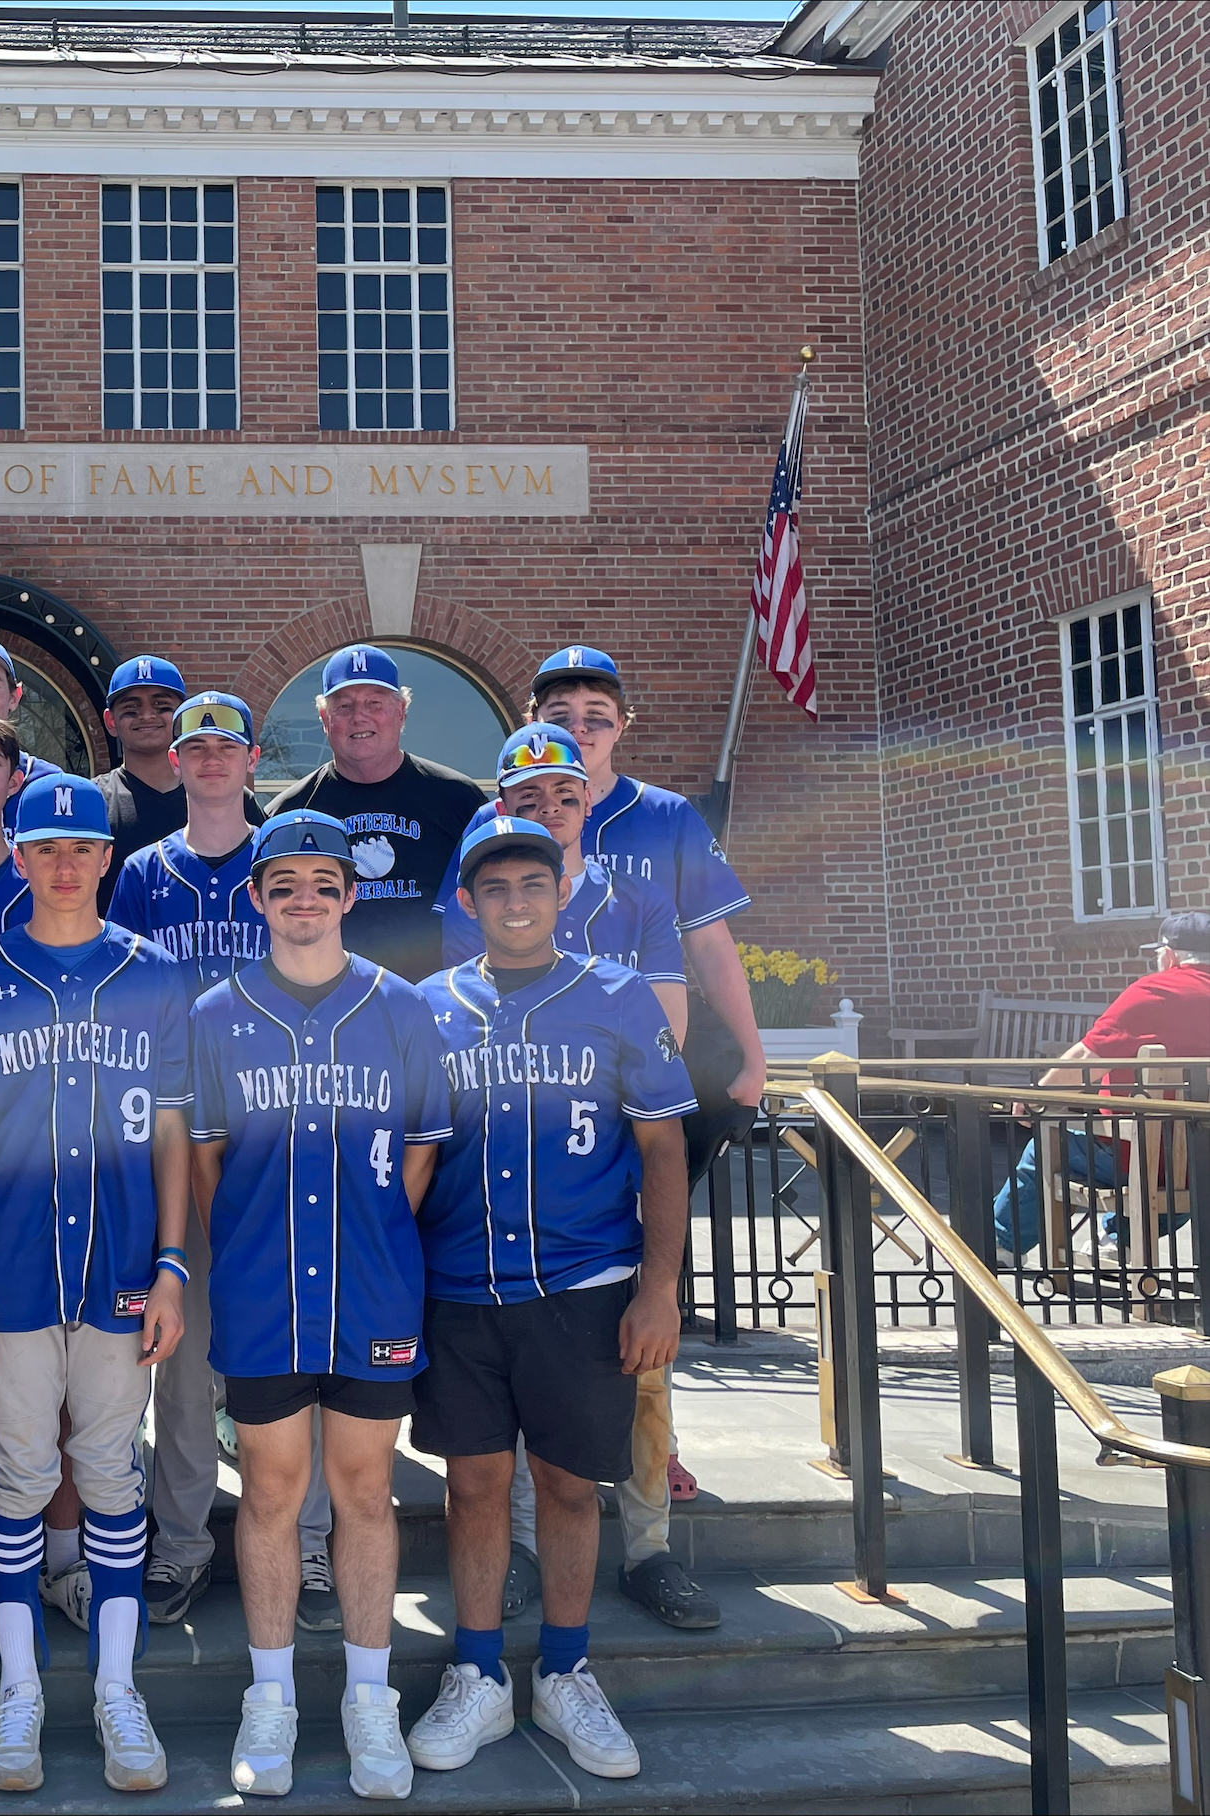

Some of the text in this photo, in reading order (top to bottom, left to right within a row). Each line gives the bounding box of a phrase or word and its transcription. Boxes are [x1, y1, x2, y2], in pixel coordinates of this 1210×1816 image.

[3, 463, 58, 495] OF
[88, 463, 207, 495] FAME
[236, 464, 334, 495] AND
[367, 464, 556, 496] MVSEVM
[137, 659, 153, 680] M
[351, 650, 368, 672] M
[568, 648, 585, 667] M
[54, 787, 74, 816] M
[342, 813, 421, 840] NTICELLO
[152, 920, 271, 961] MONTICELL
[445, 1042, 596, 1093] ONTICELLO
[236, 1062, 391, 1114] MONTICELLO
[119, 1086, 152, 1144] 9
[566, 1099, 600, 1156] 5
[368, 1128, 394, 1188] 4
